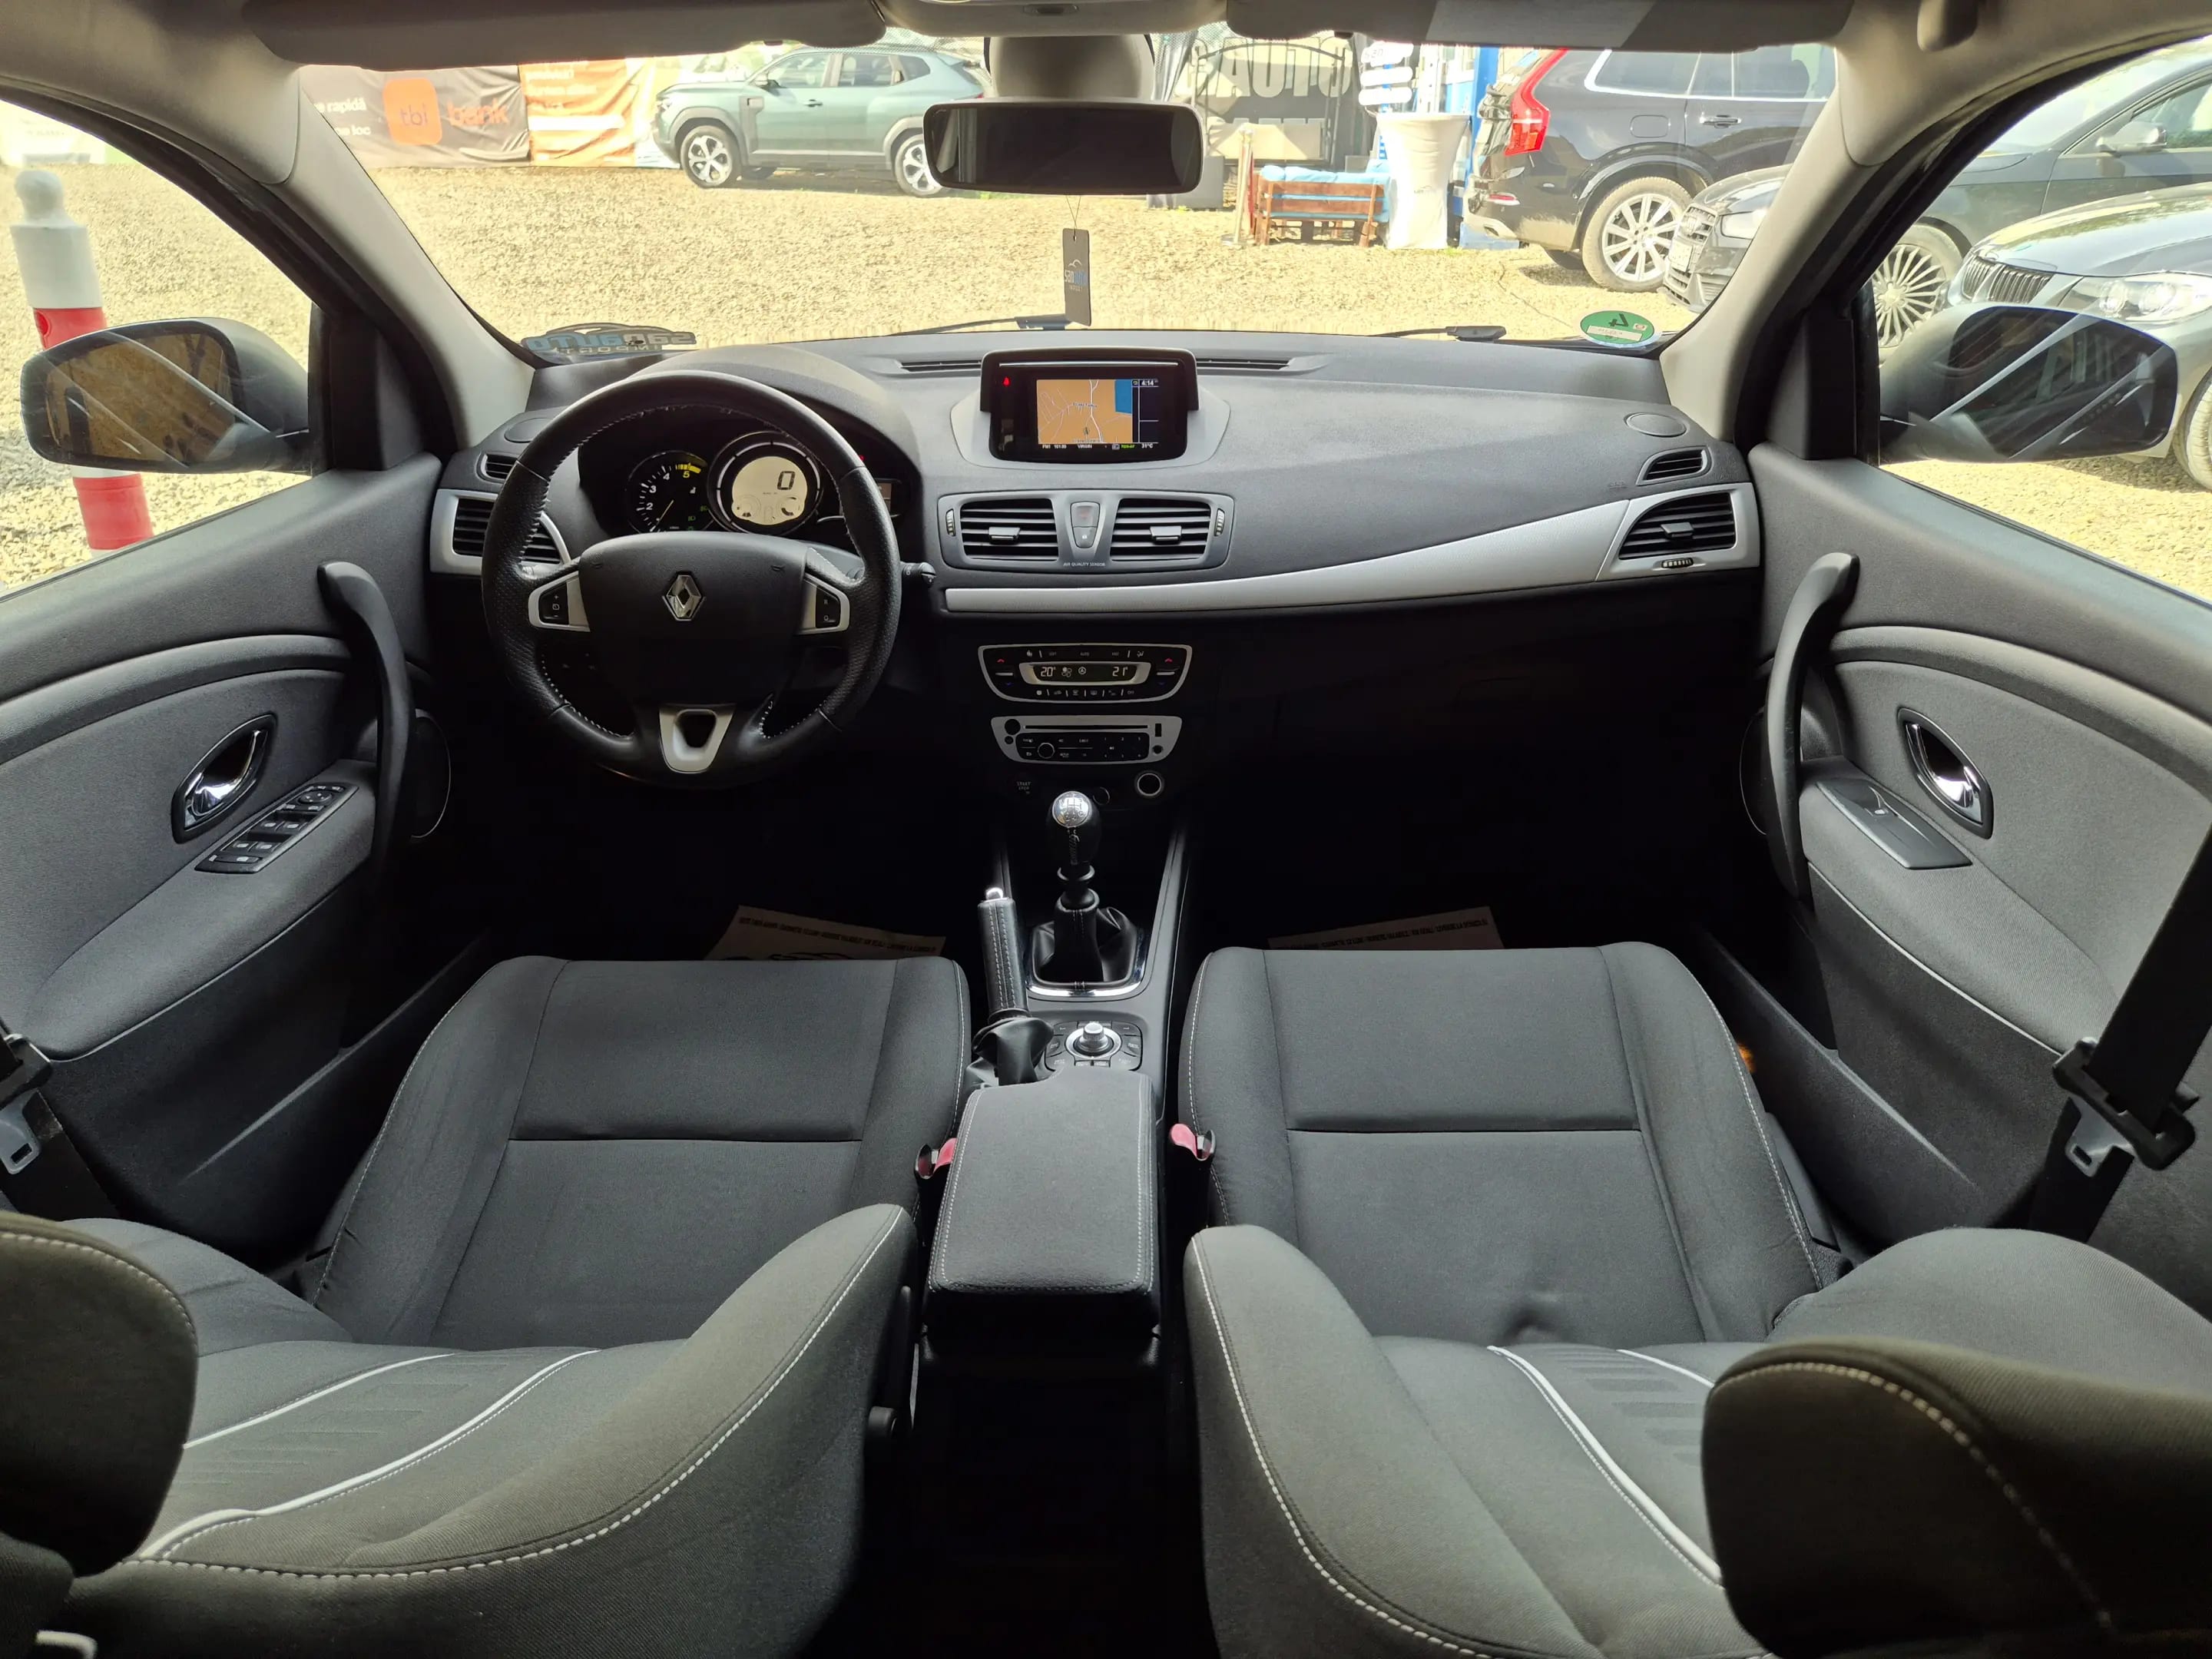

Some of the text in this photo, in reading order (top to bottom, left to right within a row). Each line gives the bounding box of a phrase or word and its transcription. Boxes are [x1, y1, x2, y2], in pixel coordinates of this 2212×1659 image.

[1216, 36, 1353, 98] AUTO
[399, 98, 510, 127] tbi bank
[662, 472, 671, 481] 4
[777, 470, 796, 492] 0
[649, 485, 657, 494] 3
[645, 502, 654, 511] 2
